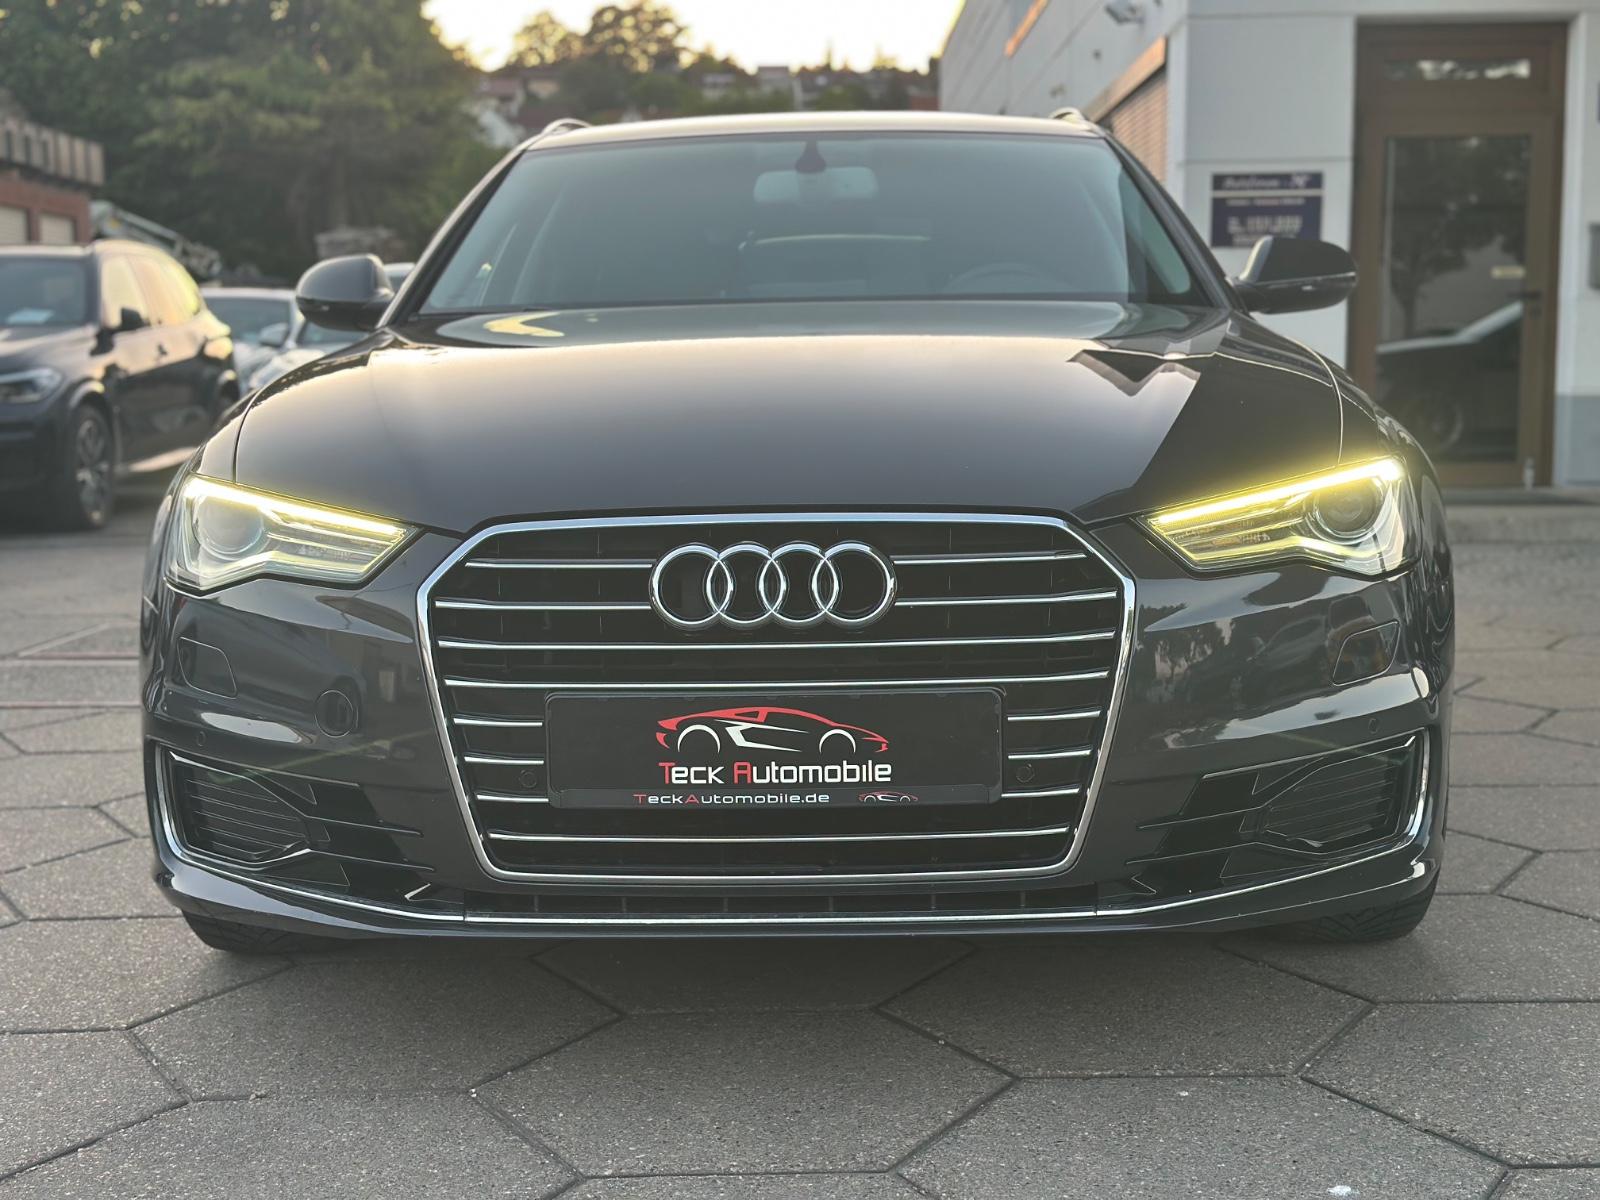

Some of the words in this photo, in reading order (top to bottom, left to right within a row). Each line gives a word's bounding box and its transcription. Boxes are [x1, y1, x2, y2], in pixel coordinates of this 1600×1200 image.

[658, 762, 725, 785] Teck
[733, 759, 892, 785] Automobile
[633, 793, 830, 804] TeckAutomobile.de
